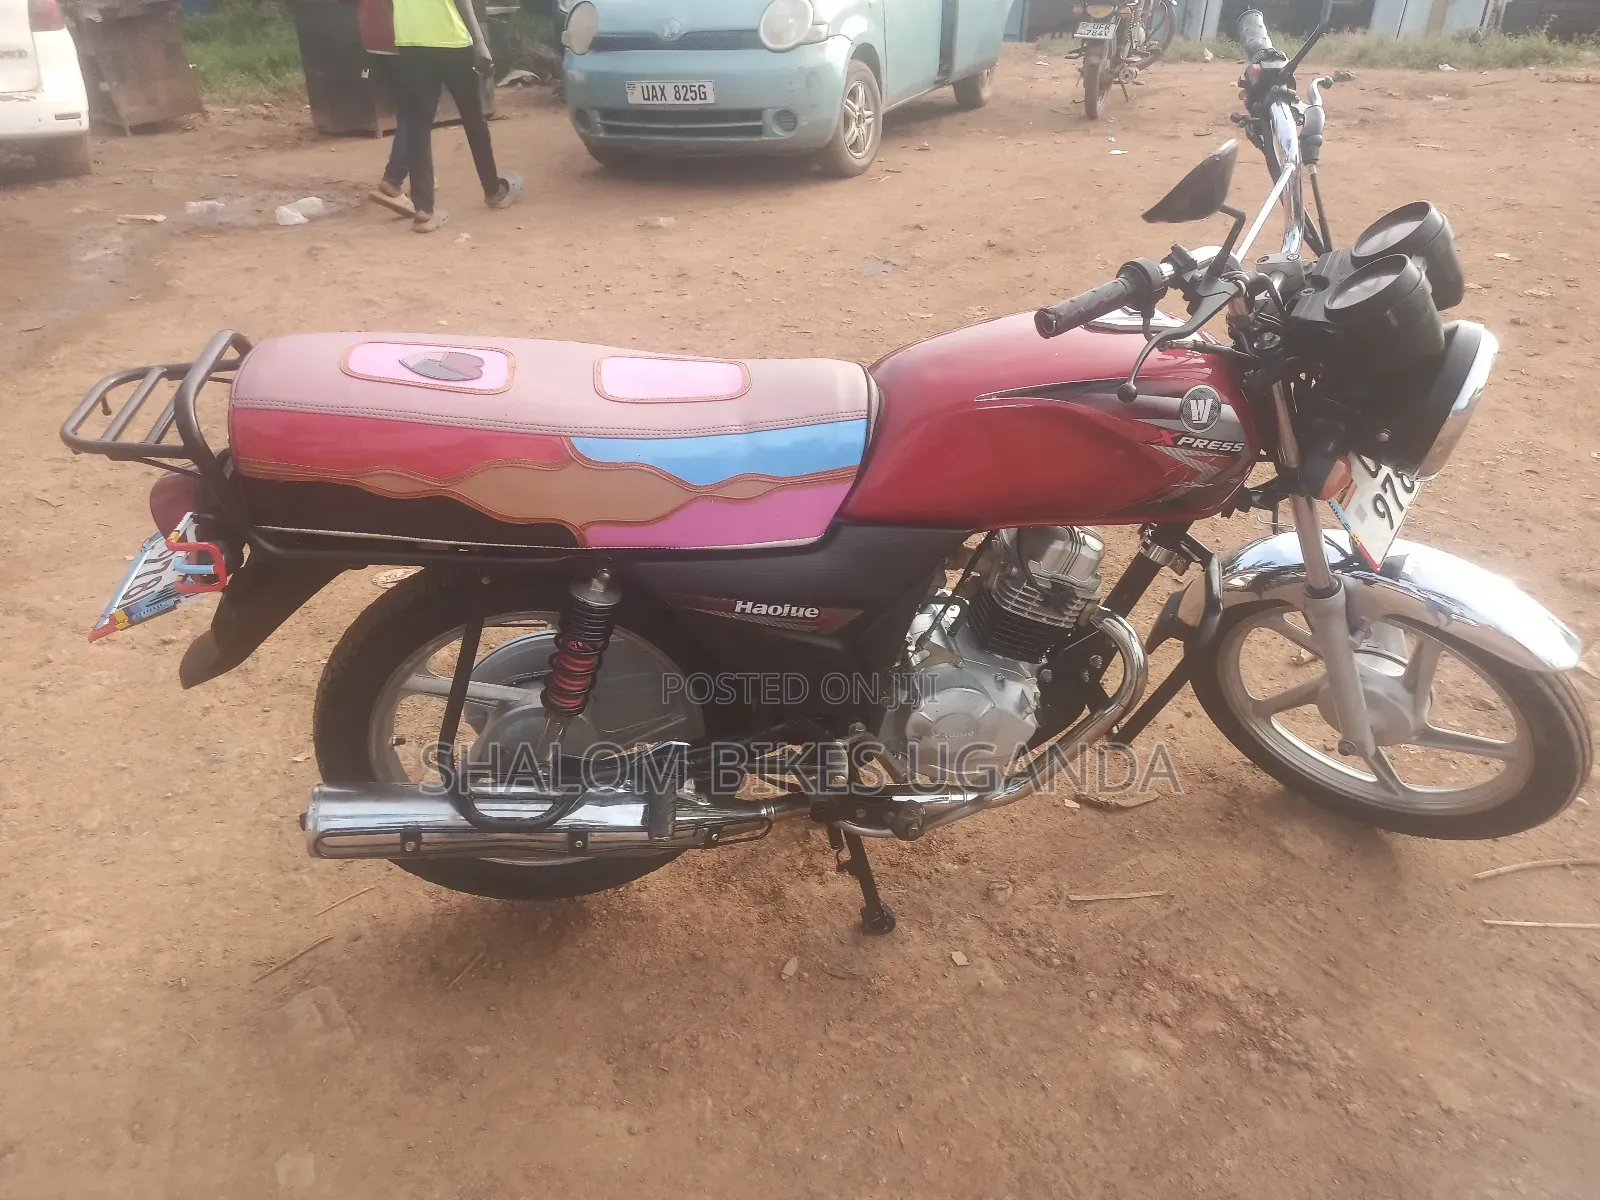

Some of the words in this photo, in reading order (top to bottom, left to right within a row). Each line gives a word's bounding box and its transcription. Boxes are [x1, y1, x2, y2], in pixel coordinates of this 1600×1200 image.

[641, 84, 668, 102] UAX
[673, 84, 708, 102] 825G
[1149, 429, 1246, 453] XPRESS
[116, 549, 177, 610] 978
[734, 600, 820, 618] Haojue
